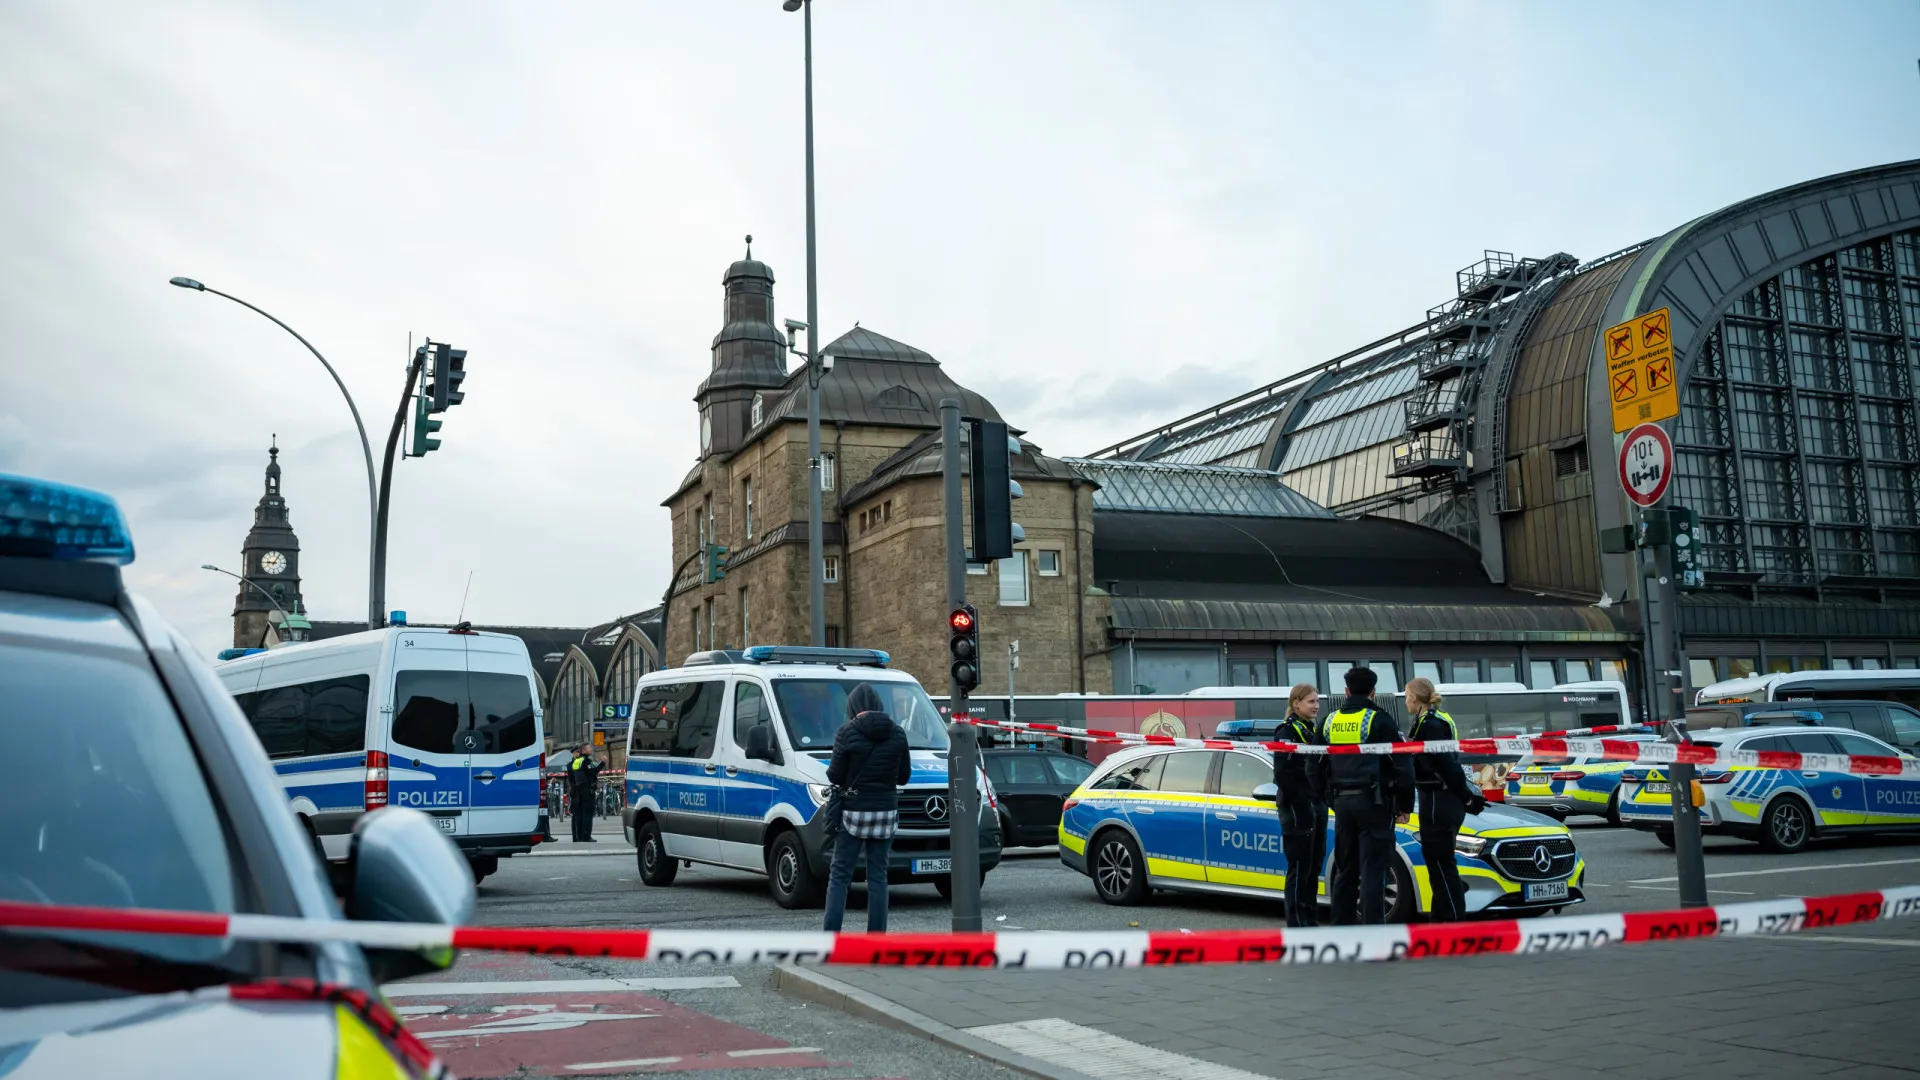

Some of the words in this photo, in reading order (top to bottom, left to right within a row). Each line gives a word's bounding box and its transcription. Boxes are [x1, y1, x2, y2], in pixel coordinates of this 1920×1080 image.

[1611, 358, 1635, 371] Waffen
[1637, 346, 1669, 362] verboten
[404, 640, 415, 648] 34
[605, 705, 615, 717] S
[619, 705, 628, 717] U
[1331, 722, 1359, 732] POLIZEI
[398, 791, 463, 806] POLIZEI
[679, 791, 707, 806] POLIZEI
[1221, 829, 1284, 853] POLIZEI
[921, 861, 933, 870] HH
[1533, 885, 1544, 896] HH
[1548, 883, 1565, 895] 7168
